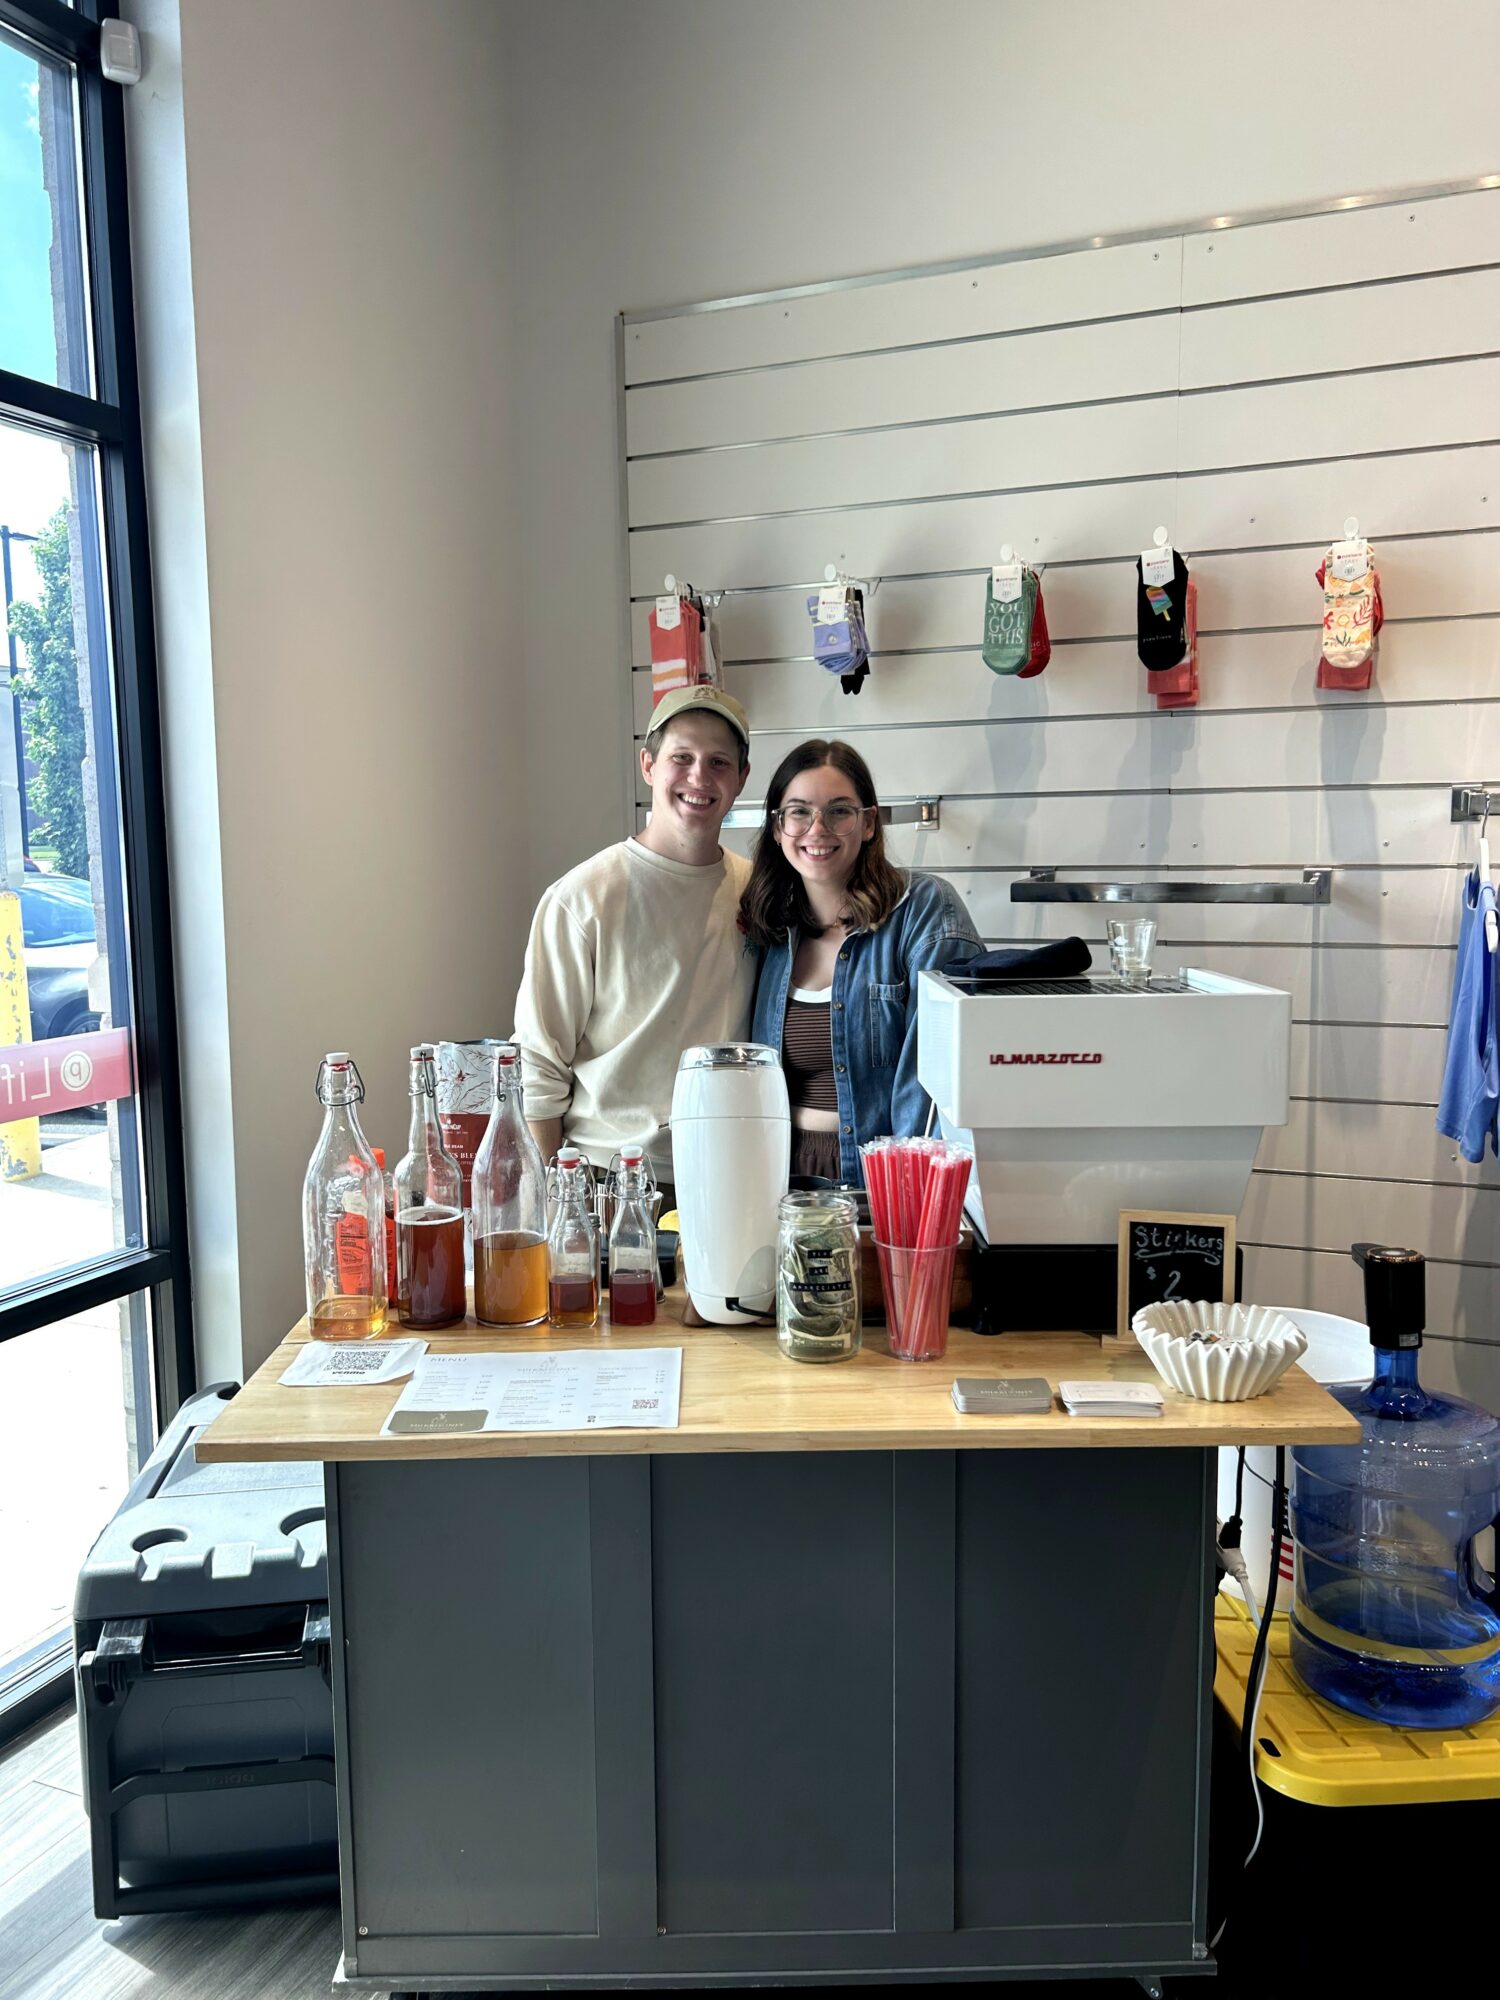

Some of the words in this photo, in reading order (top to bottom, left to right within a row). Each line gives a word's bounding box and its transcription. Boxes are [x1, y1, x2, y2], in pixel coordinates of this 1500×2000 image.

[989, 612, 1024, 634] GOT
[988, 629, 1024, 644] THIS
[1011, 1053, 1102, 1065] MARZOCCO
[1163, 1270, 1182, 1300] 2
